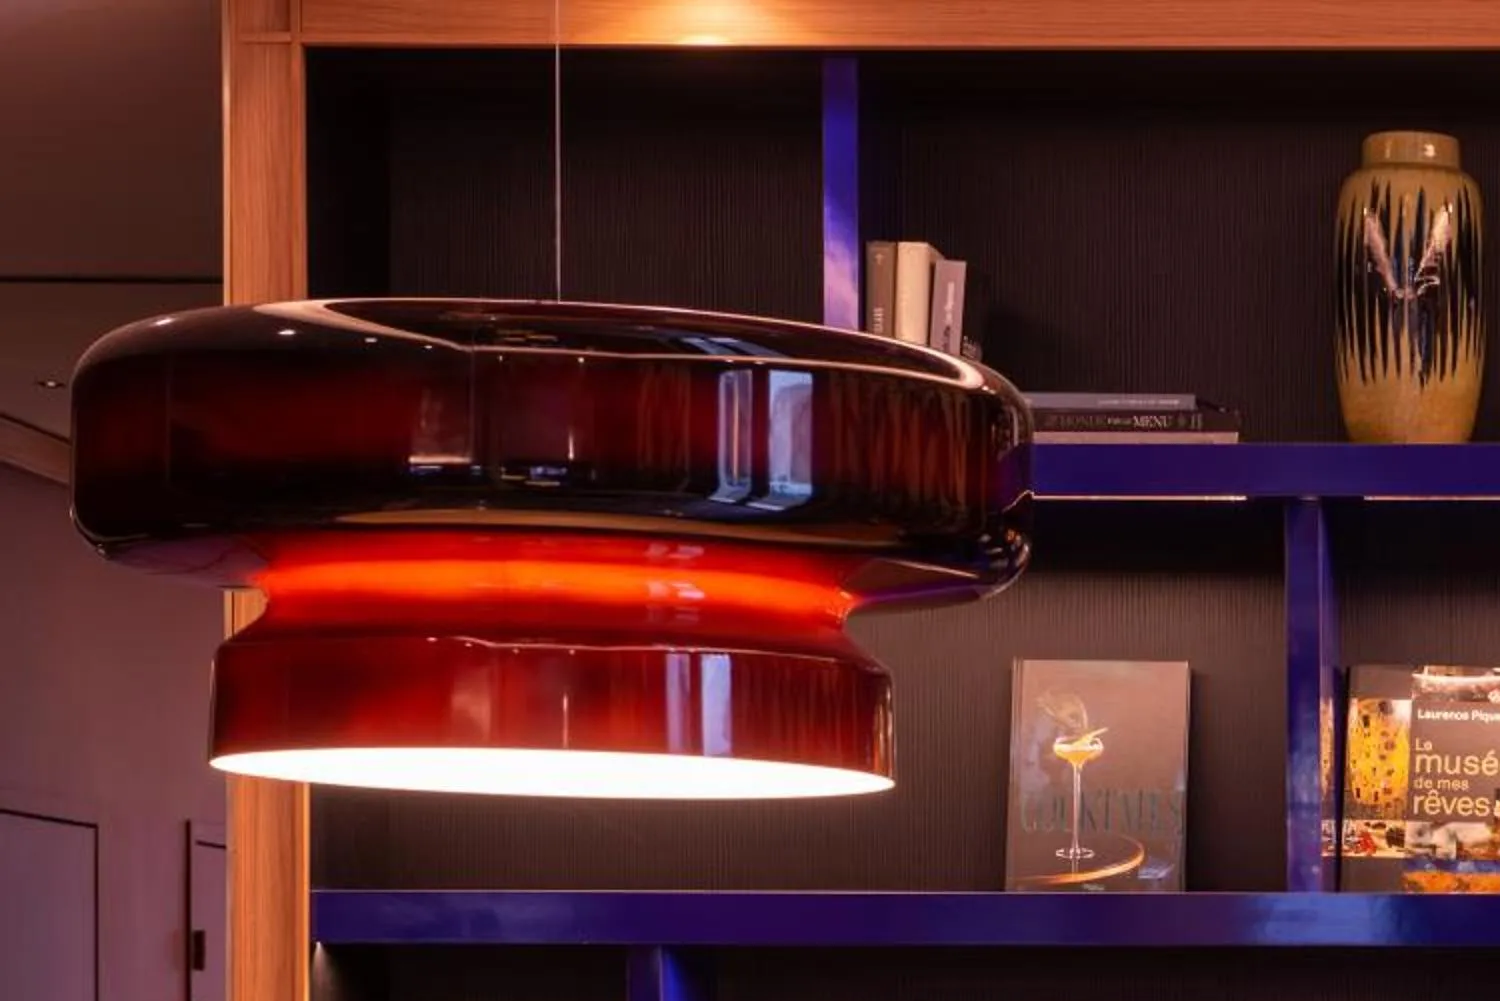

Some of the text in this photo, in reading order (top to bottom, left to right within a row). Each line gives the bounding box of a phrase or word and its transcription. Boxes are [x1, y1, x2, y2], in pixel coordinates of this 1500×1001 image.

[1133, 415, 1172, 428] MENU
[1417, 709, 1469, 720] Laurence
[1414, 777, 1469, 791] de mes
[1413, 789, 1490, 817] rêves
